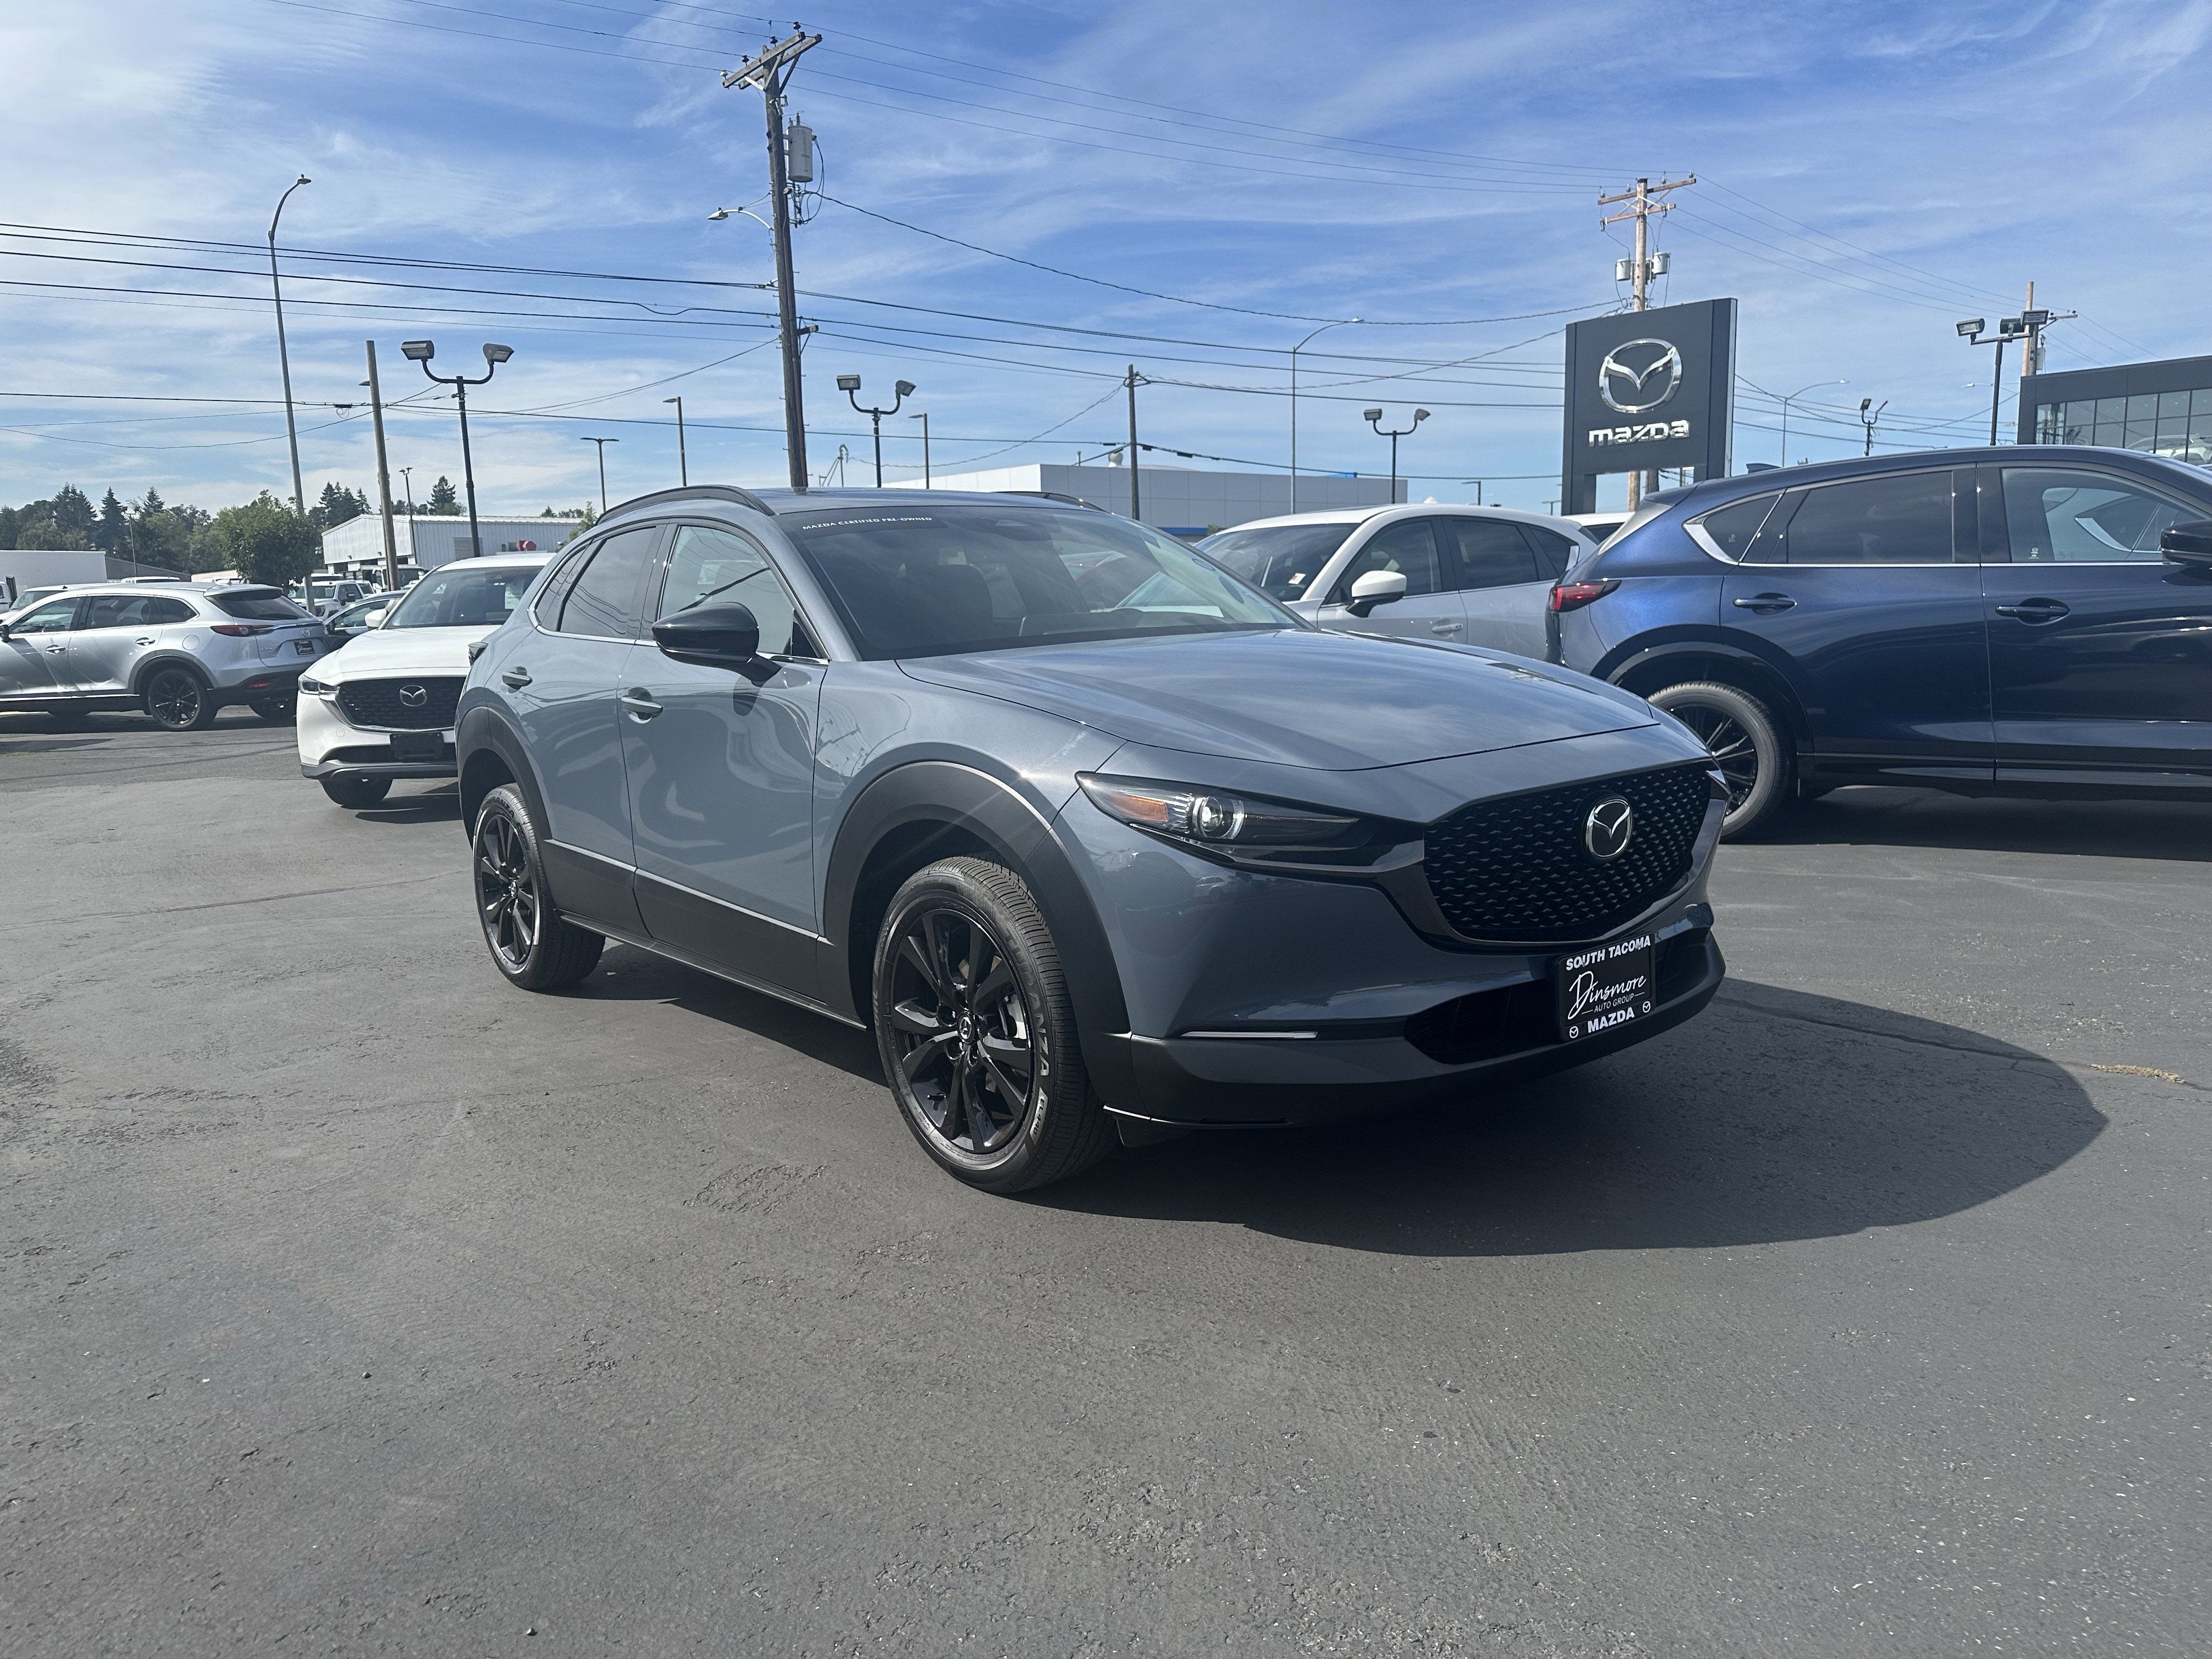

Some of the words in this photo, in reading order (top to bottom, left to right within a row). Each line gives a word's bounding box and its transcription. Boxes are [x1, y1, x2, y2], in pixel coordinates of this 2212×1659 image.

[1566, 949, 1605, 970] SOUTH
[1609, 935, 1651, 960] TACOMA
[1567, 970, 1646, 1020] Dinsmore
[1594, 1001, 1611, 1013] AUTO
[1612, 992, 1634, 1007] GROUP
[1587, 1007, 1635, 1033] MAZDA
[1033, 1098, 1045, 1134] EL440
